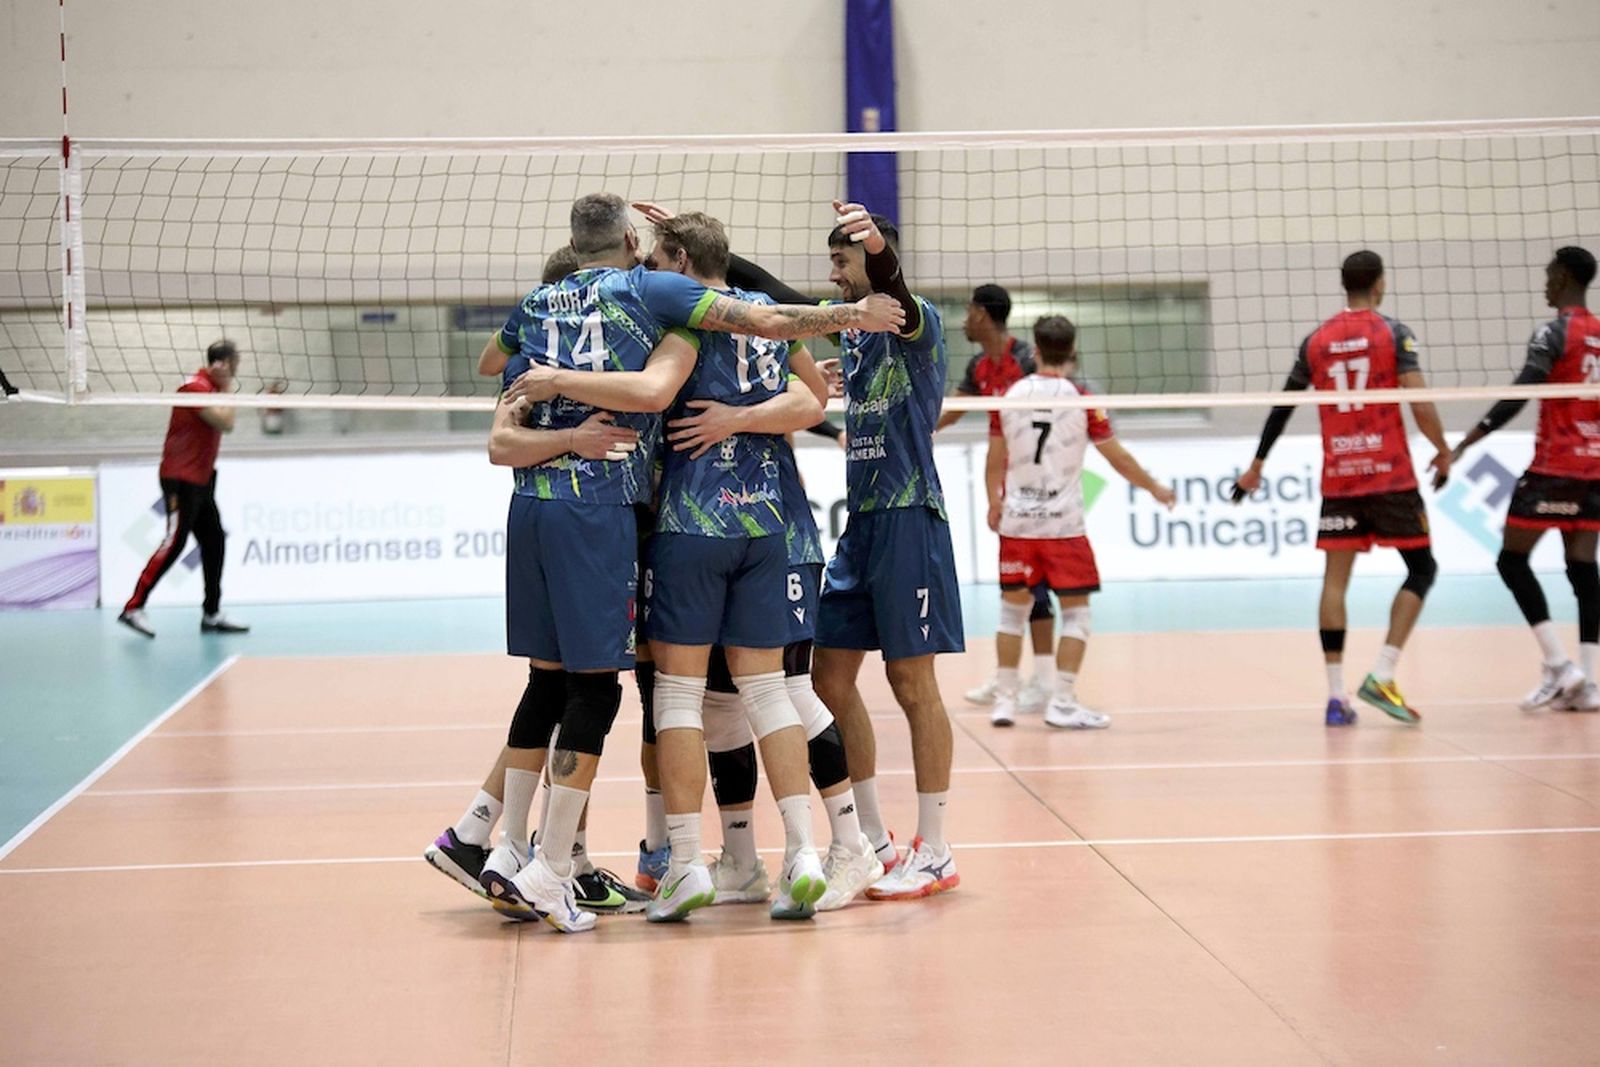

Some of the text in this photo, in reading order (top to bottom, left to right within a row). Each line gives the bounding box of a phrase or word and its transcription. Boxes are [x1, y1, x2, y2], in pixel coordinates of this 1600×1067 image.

[548, 282, 600, 313] BORJA
[542, 310, 610, 371] 14
[1328, 356, 1370, 413] 17
[1032, 421, 1052, 465] 7
[241, 500, 446, 533] Reciclados
[1130, 508, 1309, 557] Unicaja
[242, 536, 443, 567] Almerienses
[786, 572, 804, 602] 6
[916, 588, 929, 618] 7
